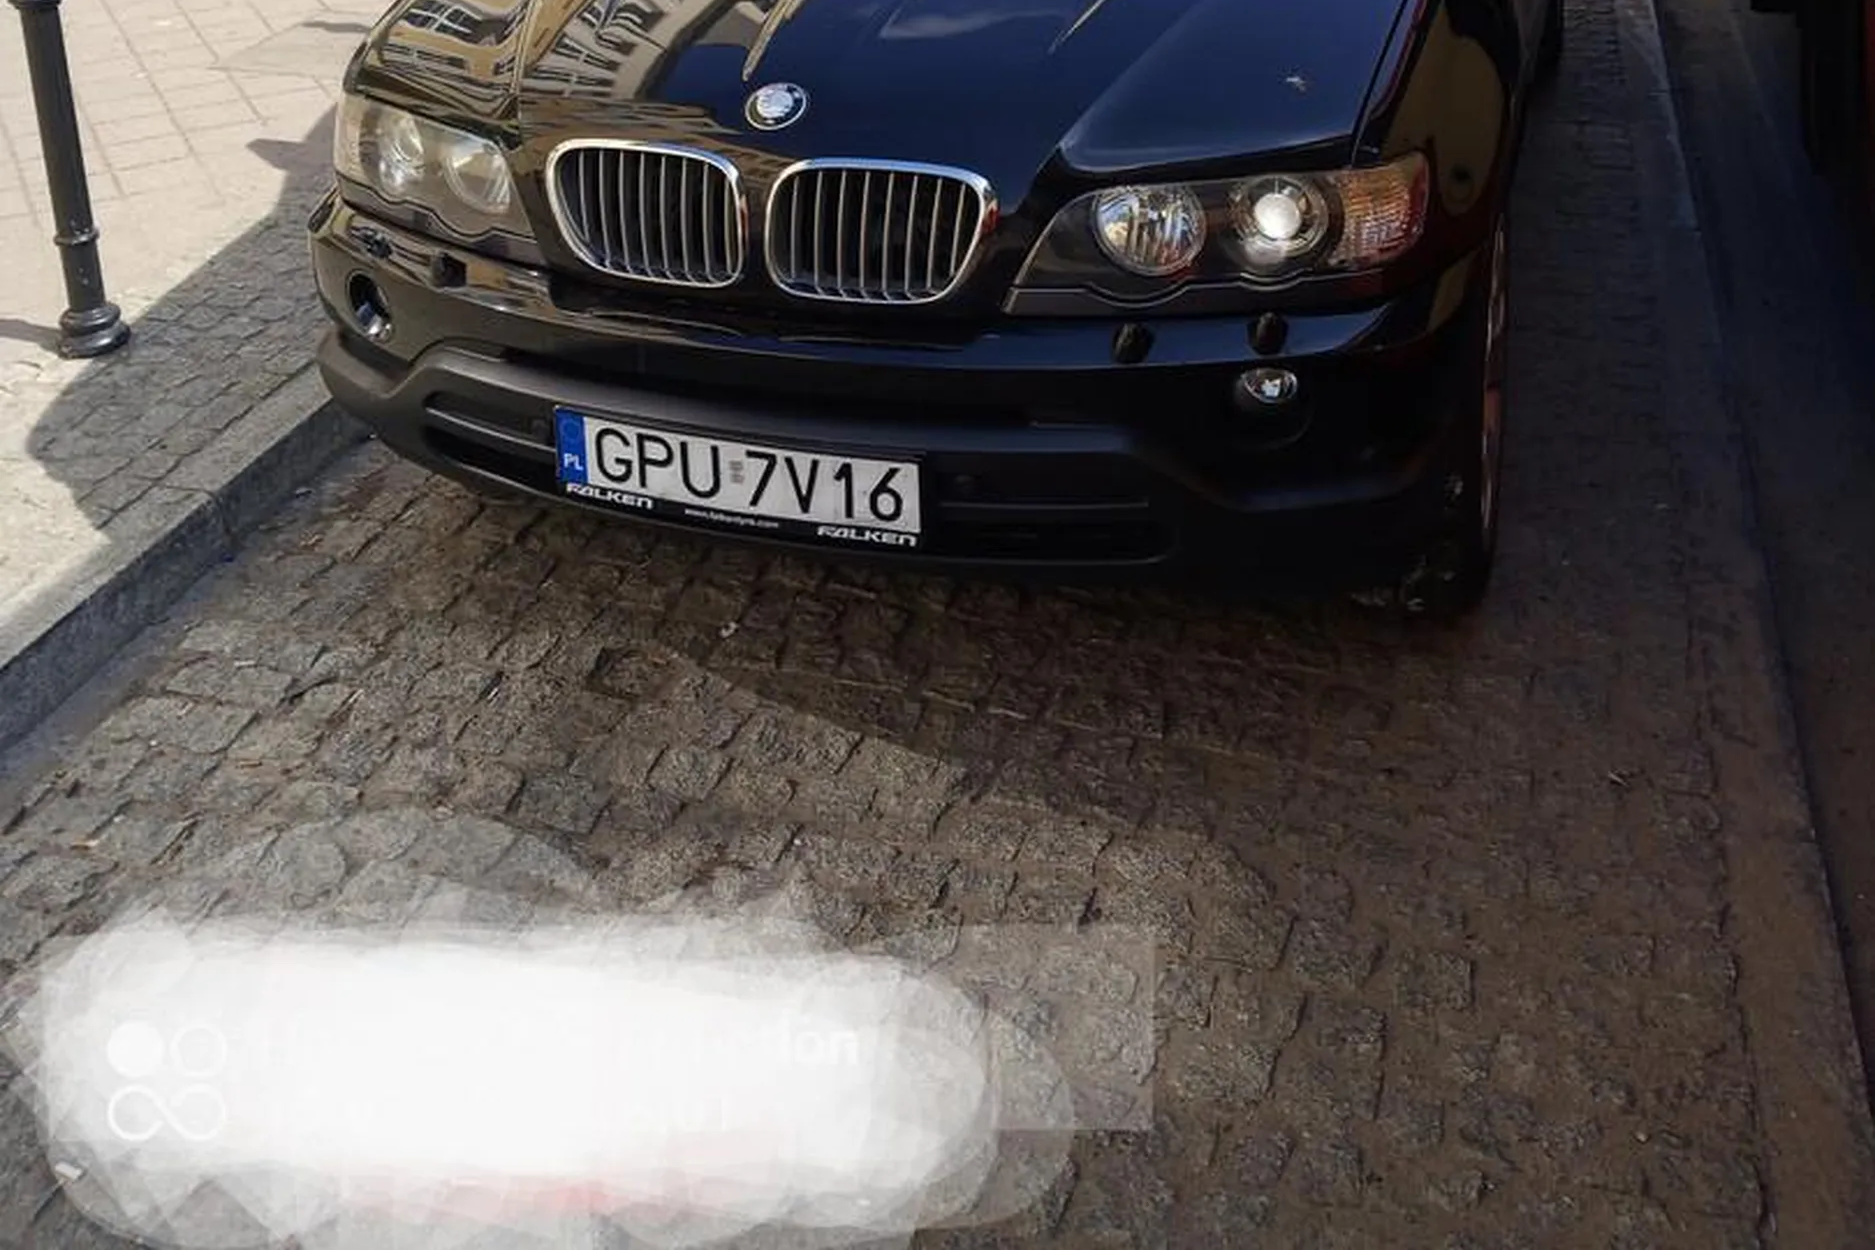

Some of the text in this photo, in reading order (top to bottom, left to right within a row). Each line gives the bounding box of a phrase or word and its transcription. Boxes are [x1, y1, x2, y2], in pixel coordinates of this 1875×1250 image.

[563, 452, 584, 472] PL
[595, 427, 903, 523] GPU 7V16
[565, 482, 653, 510] FALKEN
[816, 524, 917, 547] FALKEN
